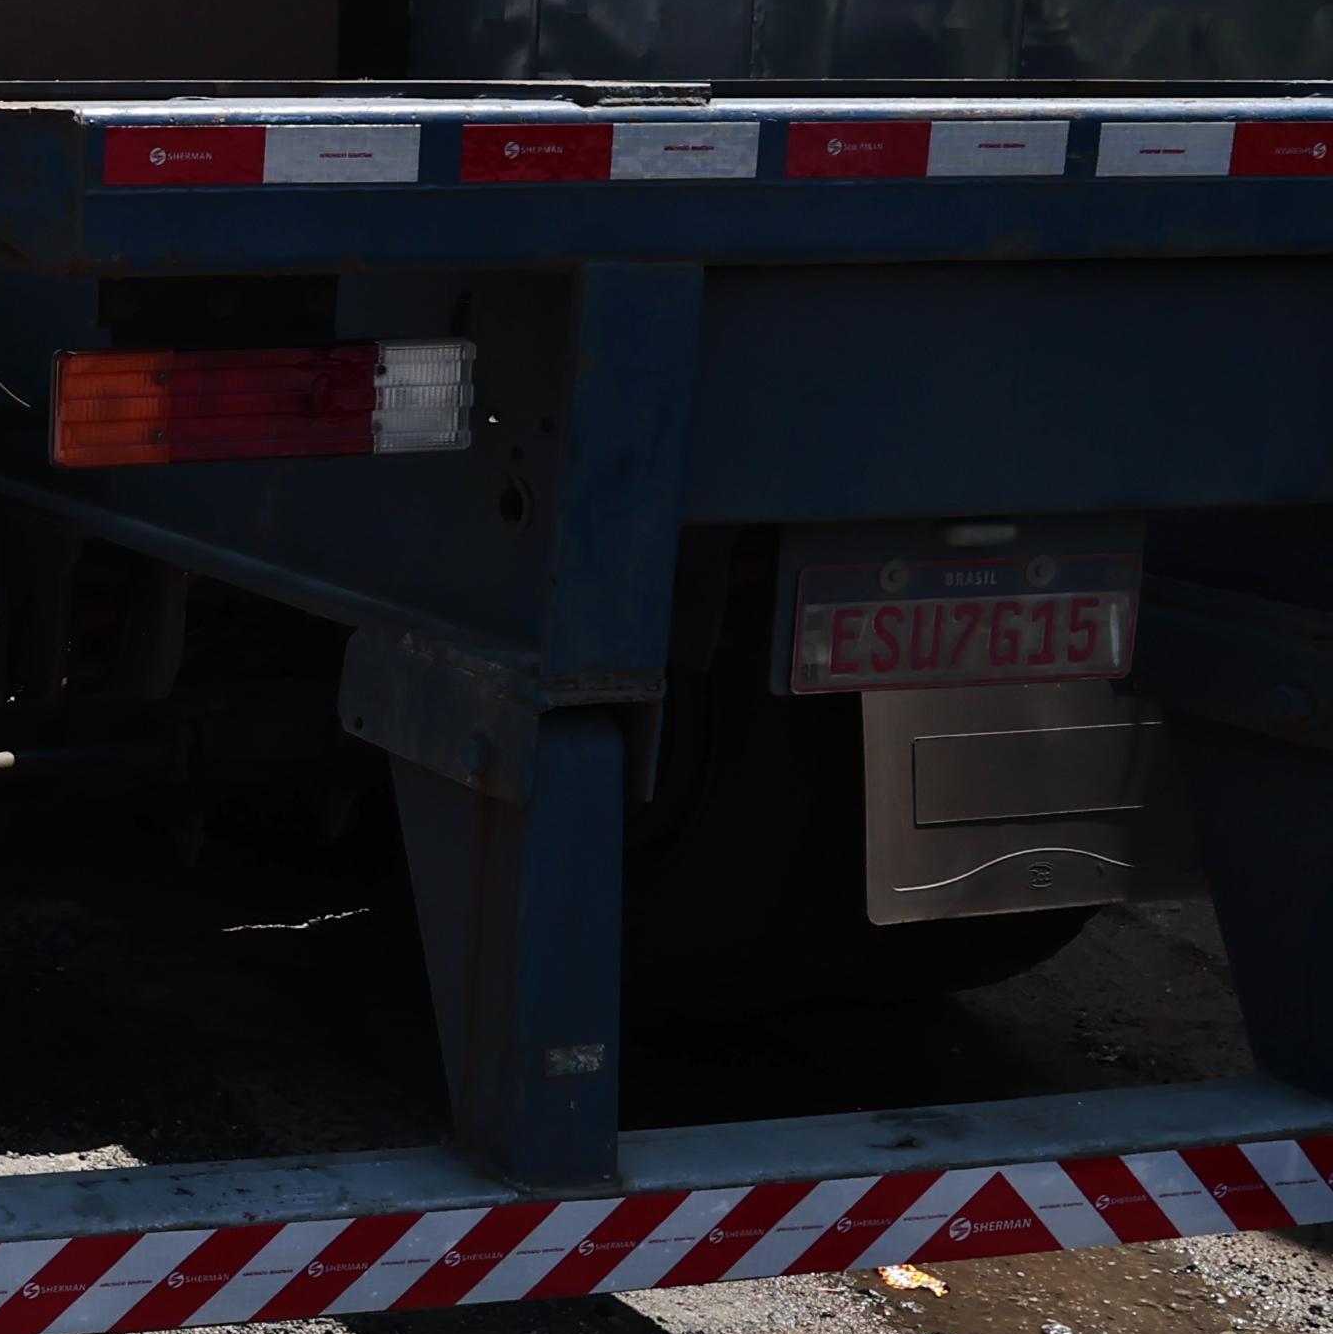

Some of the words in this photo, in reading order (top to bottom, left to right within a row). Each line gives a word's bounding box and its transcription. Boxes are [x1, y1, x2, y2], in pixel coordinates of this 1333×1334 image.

[166, 151, 214, 161] SHERMAN
[944, 570, 997, 588] BRASIL
[829, 596, 1101, 676] ESU7G15
[972, 1217, 1032, 1234] SHERMAN
[724, 1228, 765, 1239] SHERMAN
[594, 1240, 636, 1251] SHERMAN
[460, 1251, 504, 1263] SHERMAN
[324, 1262, 369, 1273] SHERMAN
[184, 1273, 230, 1284] SHERMAN
[40, 1283, 86, 1295] SHERMAN
